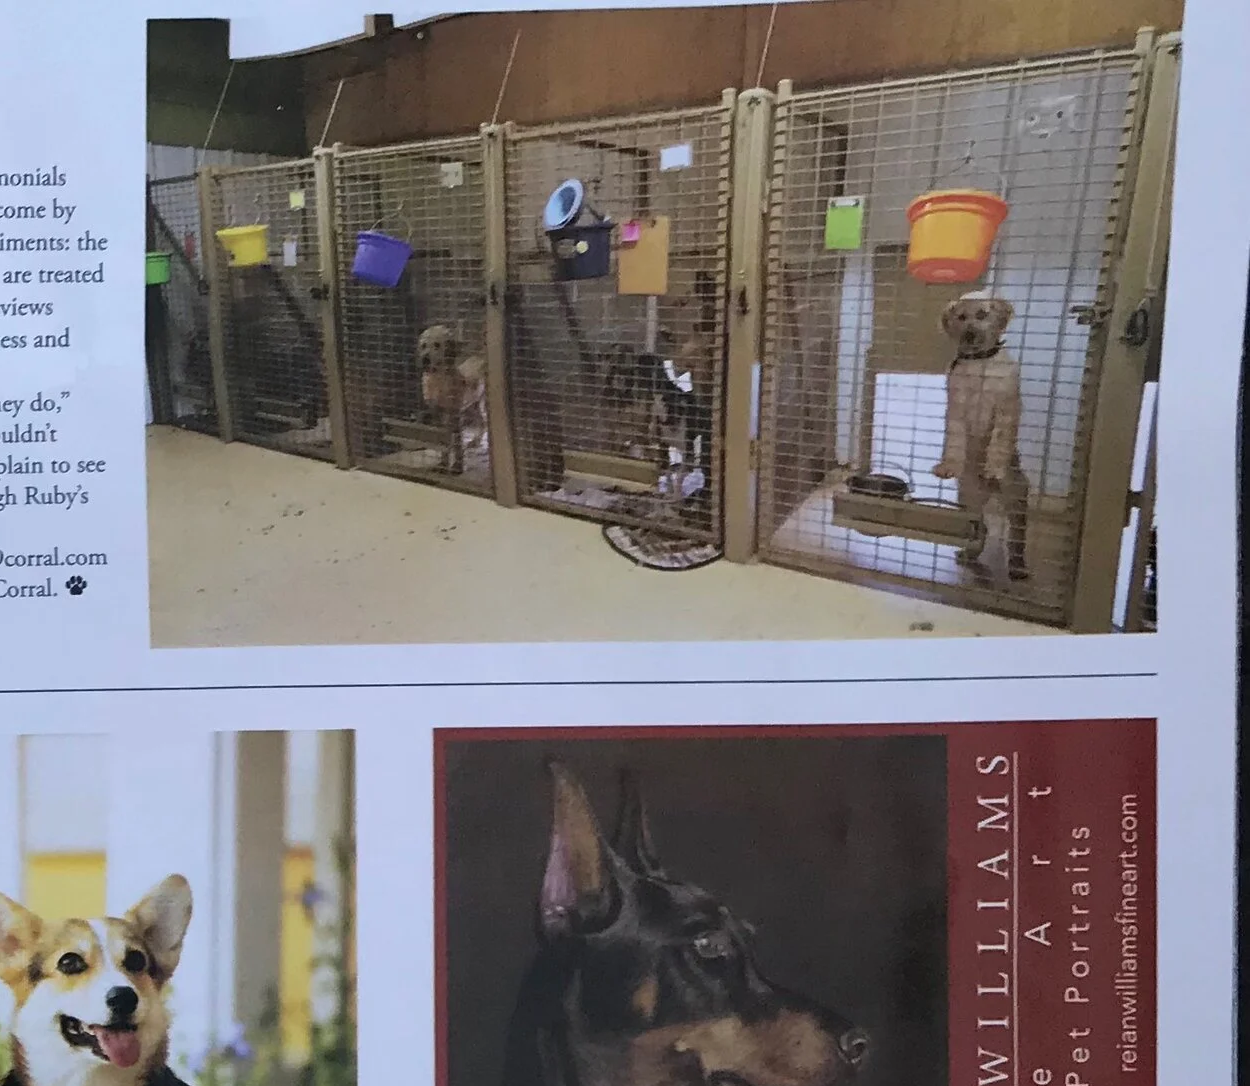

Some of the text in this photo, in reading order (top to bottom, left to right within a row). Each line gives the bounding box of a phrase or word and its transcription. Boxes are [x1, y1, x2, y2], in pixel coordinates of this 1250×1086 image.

[1024, 786, 1052, 947] Art
[1065, 826, 1090, 1003] Portraits
[1115, 794, 1137, 1072] reianwilliamsfineart.com
